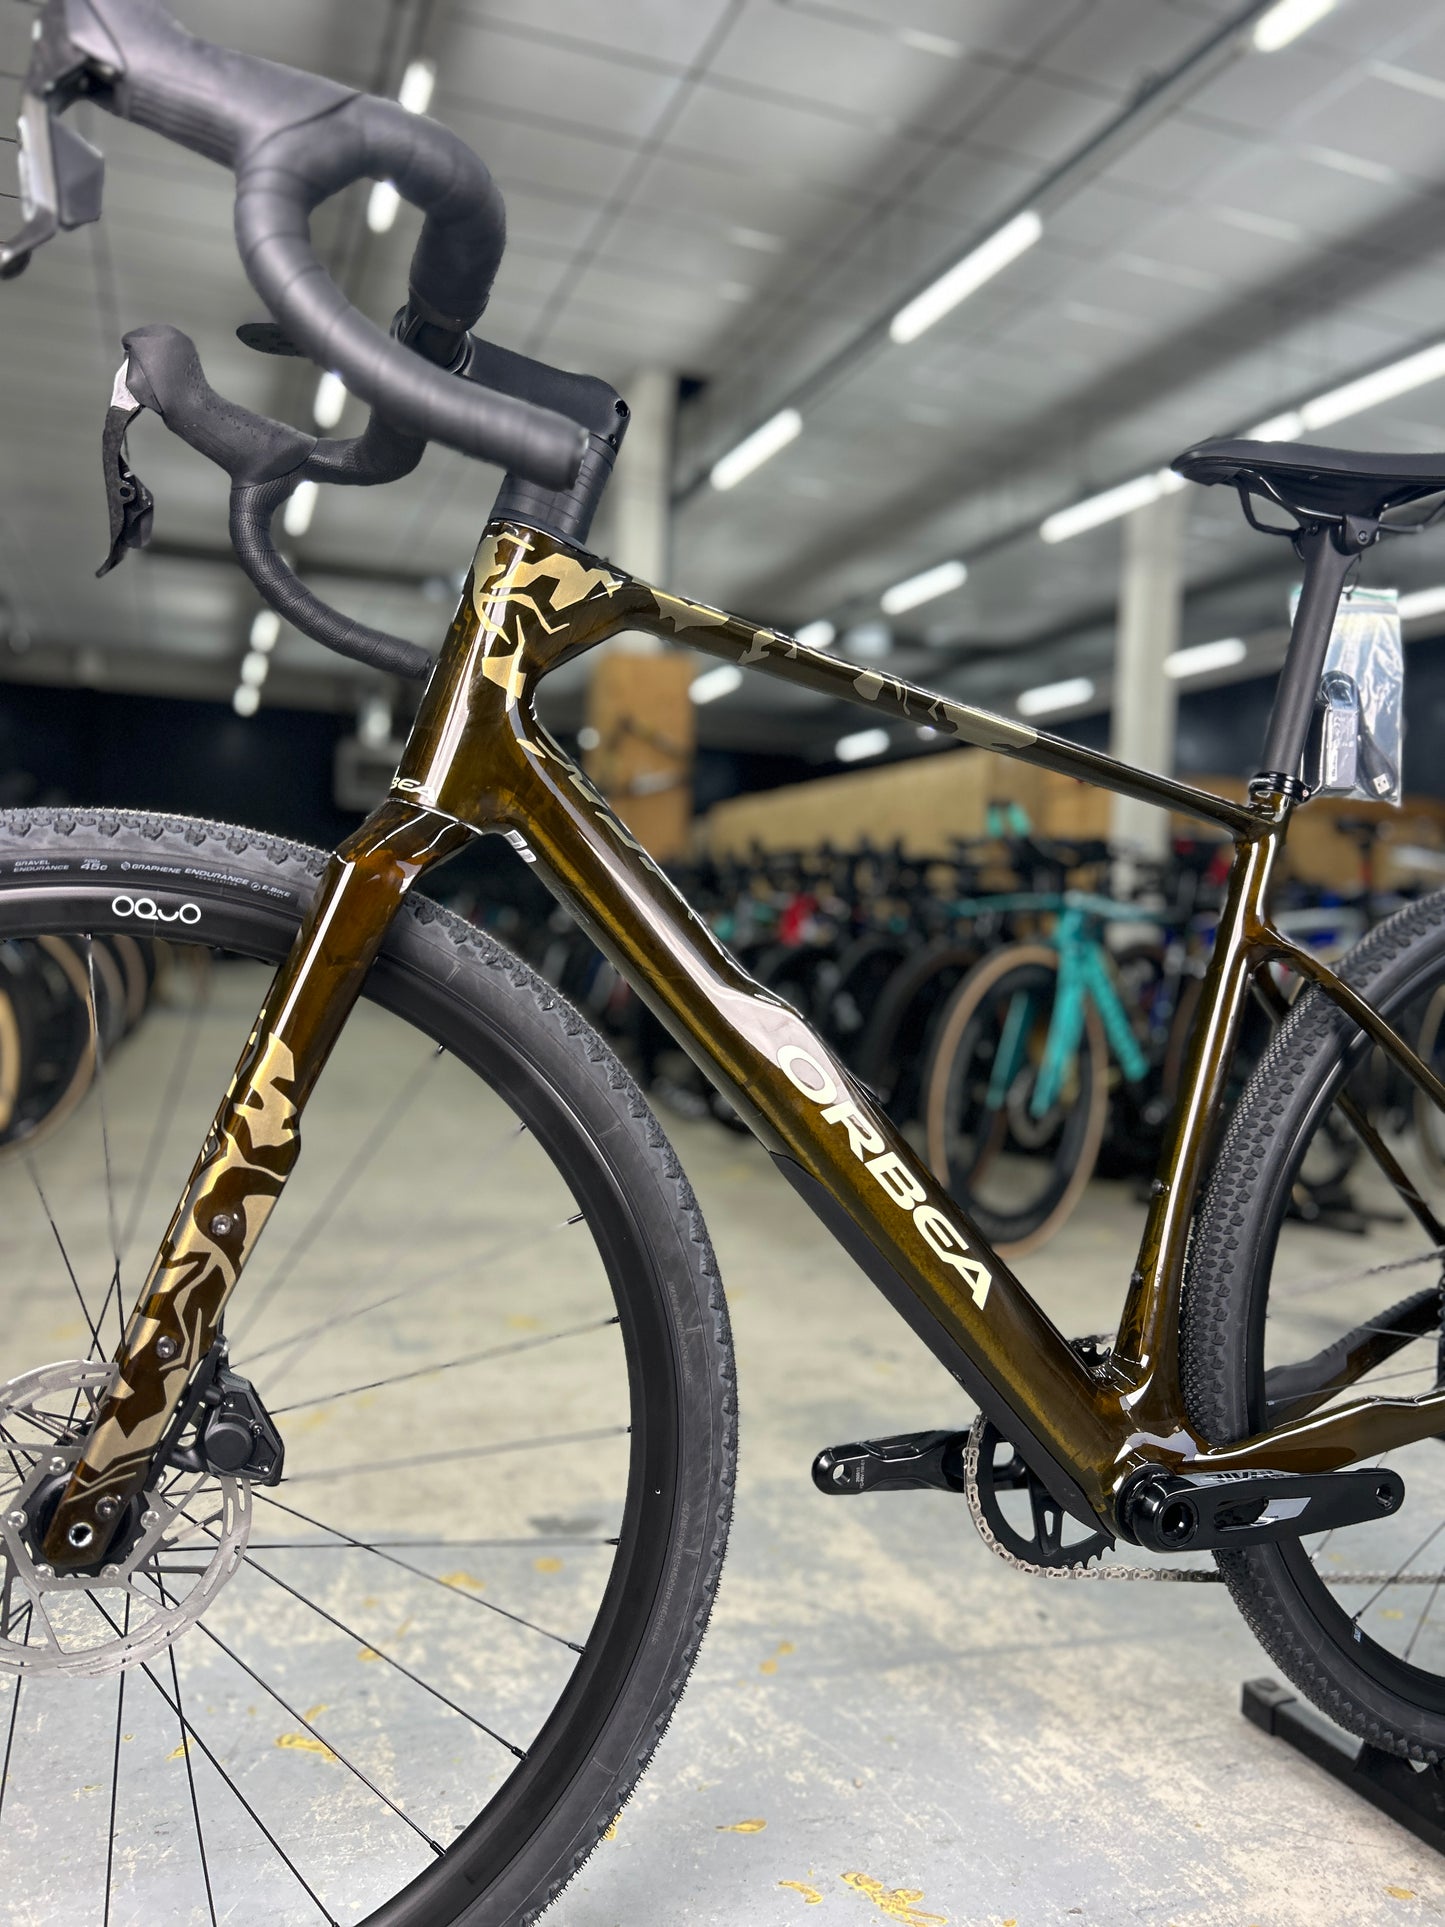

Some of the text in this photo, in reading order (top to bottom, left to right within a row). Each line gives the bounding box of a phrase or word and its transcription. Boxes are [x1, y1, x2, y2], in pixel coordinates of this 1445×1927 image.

[13, 864, 70, 873] ENDURANCE
[14, 859, 50, 867] GRAVEL
[131, 863, 250, 885] GRAPHENE ENDURANCE
[776, 1045, 993, 1311] ORBEA
